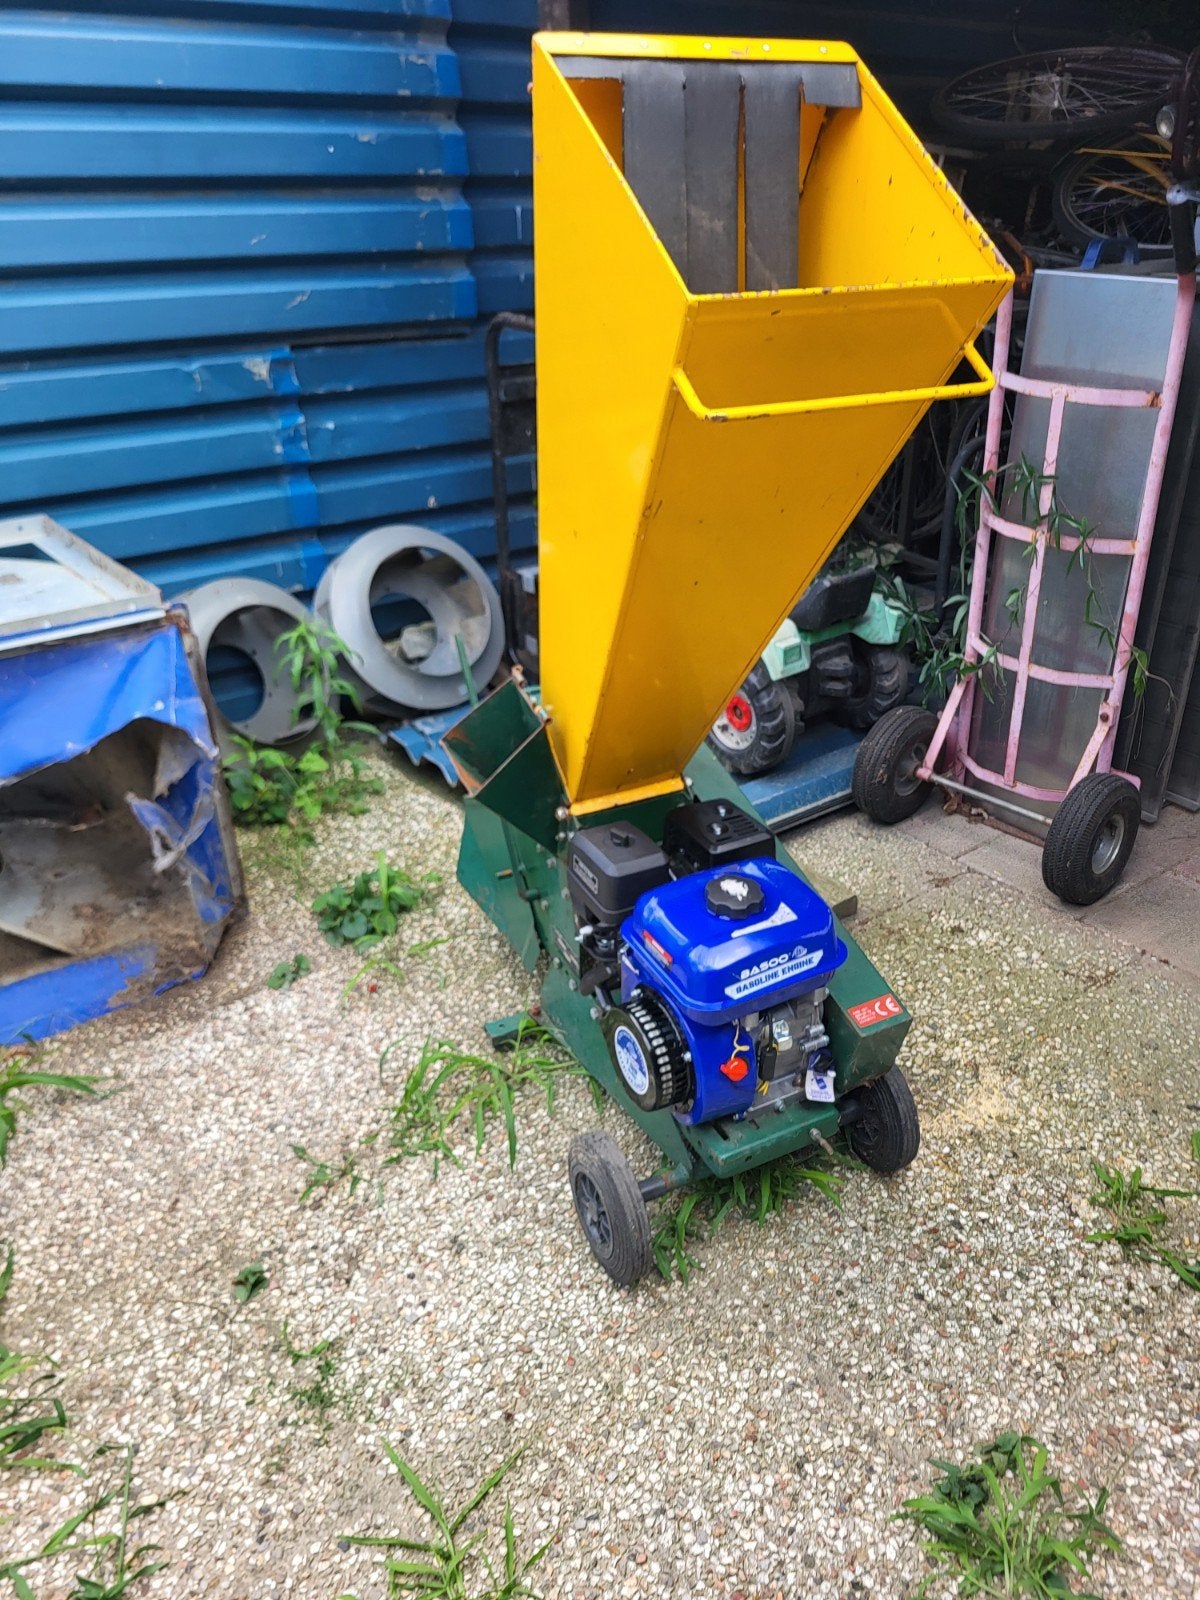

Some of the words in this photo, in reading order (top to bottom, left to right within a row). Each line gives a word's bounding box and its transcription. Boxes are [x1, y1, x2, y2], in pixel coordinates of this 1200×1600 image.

[736, 970, 780, 994] GASOLINE
[781, 956, 815, 976] ENGINE
[874, 996, 900, 1016] CE
